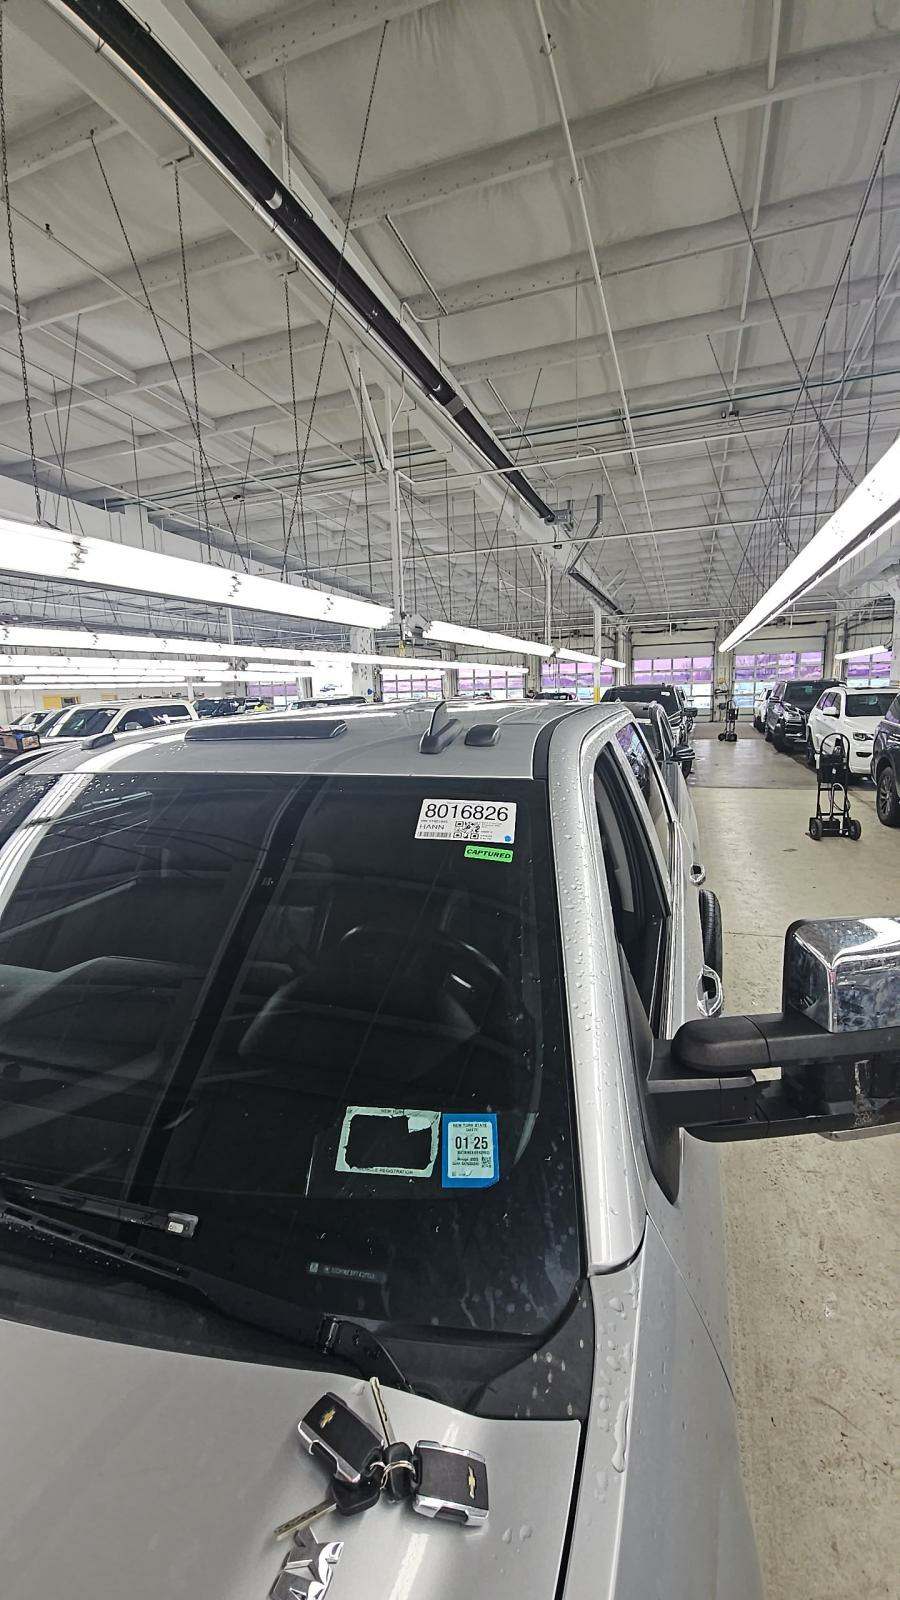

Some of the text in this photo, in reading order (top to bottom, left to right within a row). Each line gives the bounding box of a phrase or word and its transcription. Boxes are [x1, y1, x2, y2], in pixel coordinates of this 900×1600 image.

[425, 803, 508, 821] 8016826
[466, 849, 511, 859] CAPTURED
[455, 1136, 488, 1150] 01 25
